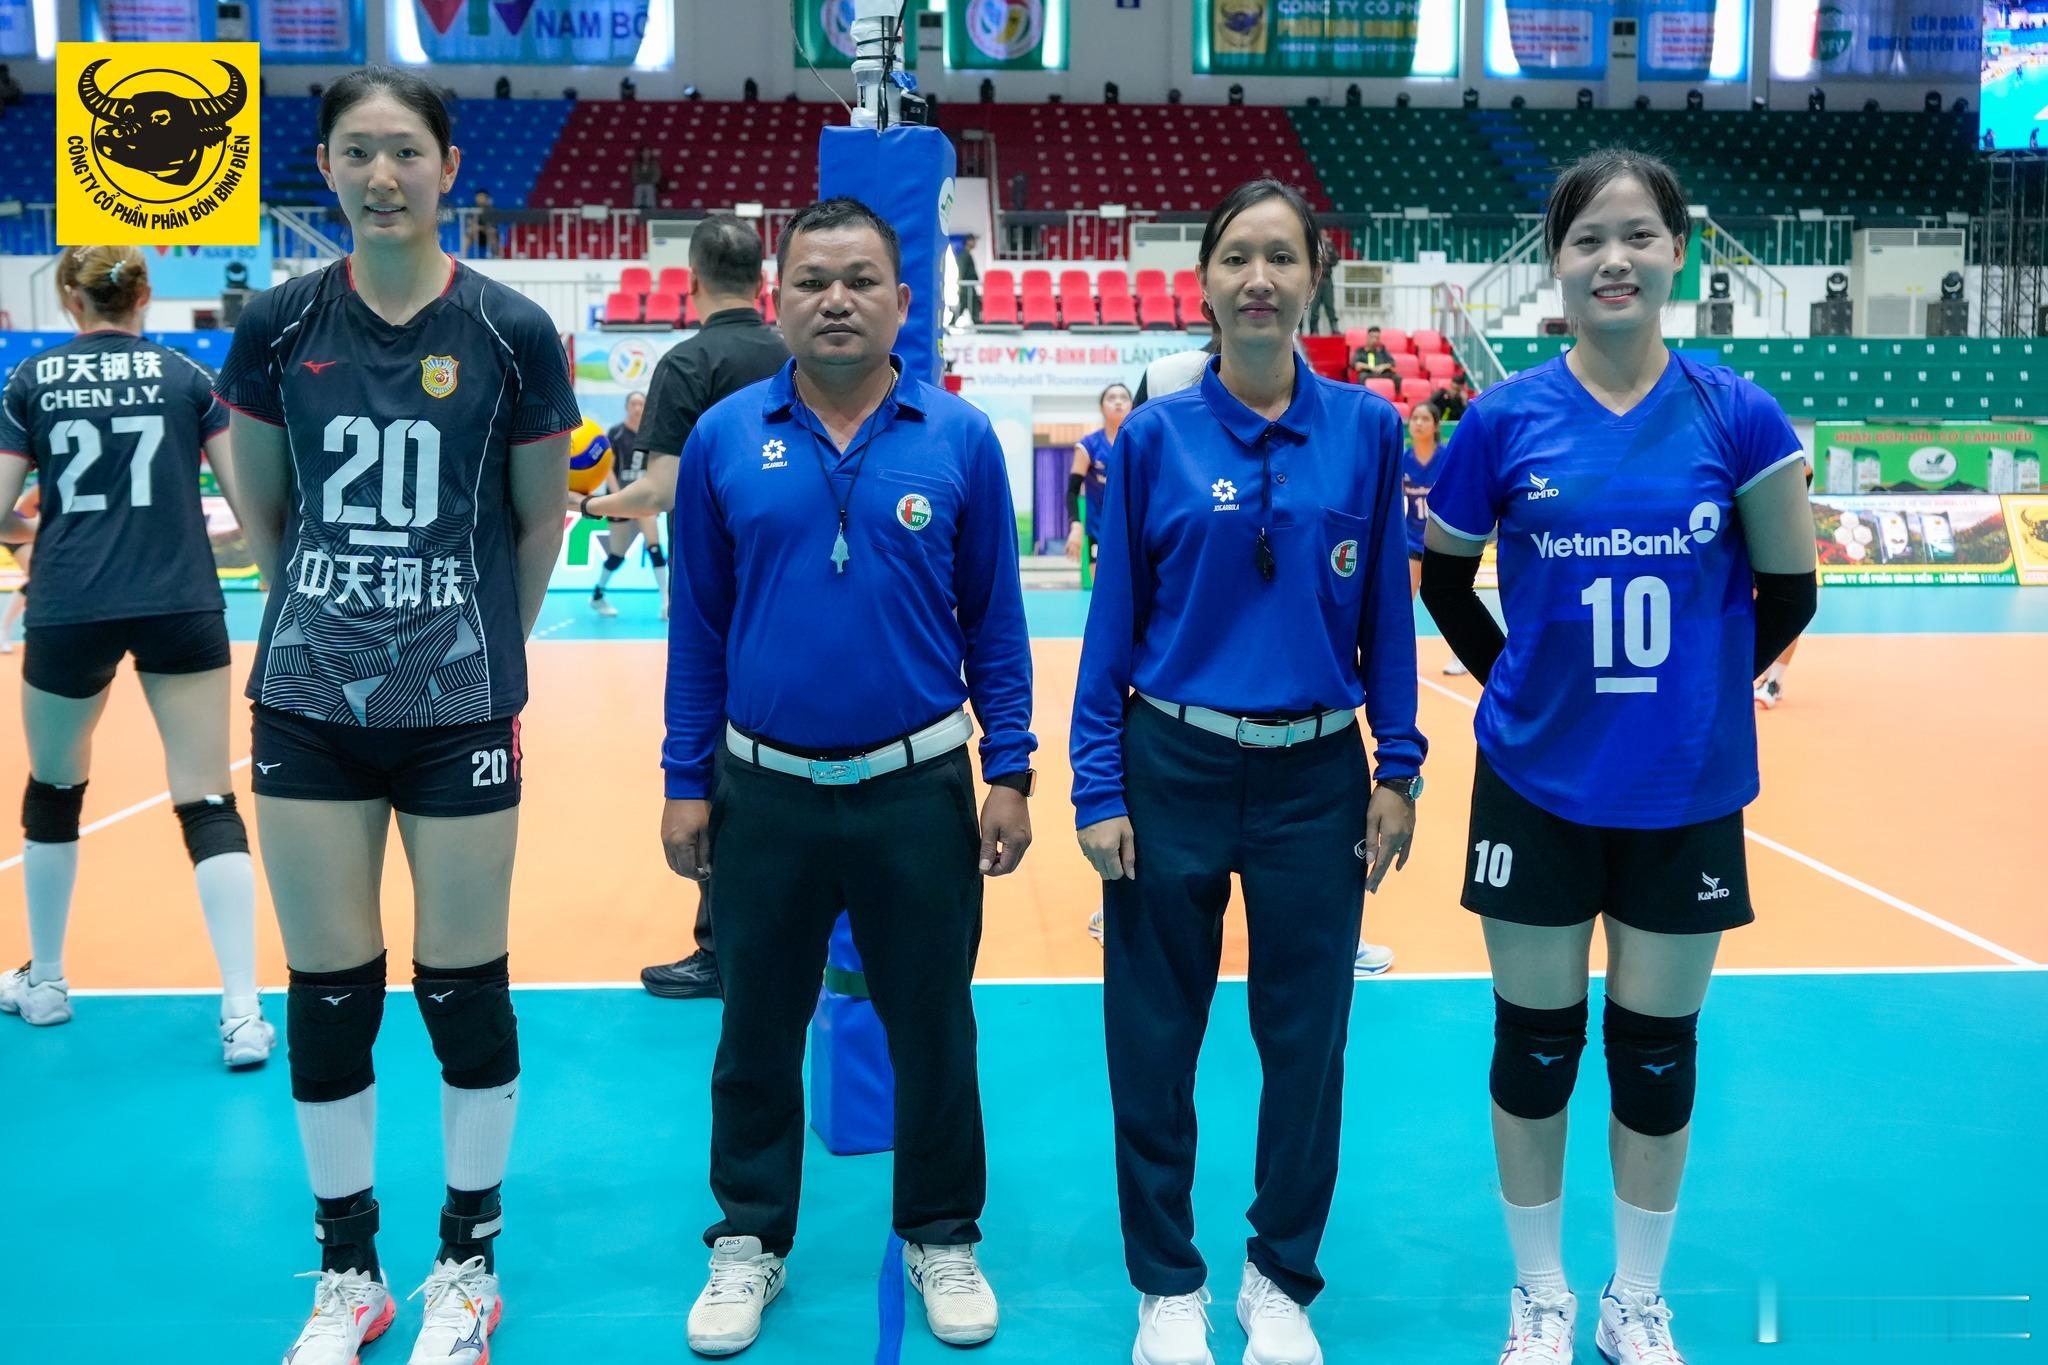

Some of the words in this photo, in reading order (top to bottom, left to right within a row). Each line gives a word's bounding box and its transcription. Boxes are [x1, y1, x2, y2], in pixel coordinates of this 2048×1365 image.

[535, 11, 601, 39] NAM
[36, 352, 163, 385] 中天钢铁
[41, 388, 113, 412] CHEN
[120, 384, 164, 406] J.Y.
[49, 415, 165, 514] 27
[322, 415, 441, 528] 20
[1527, 488, 1560, 500] KAMITO
[1530, 526, 1693, 560] VietinBank
[297, 549, 465, 608] 中天钢铁
[1581, 575, 1671, 668] 10
[472, 748, 508, 787] 20
[1474, 839, 1513, 888] 10
[1697, 888, 1730, 901] KAMITO
